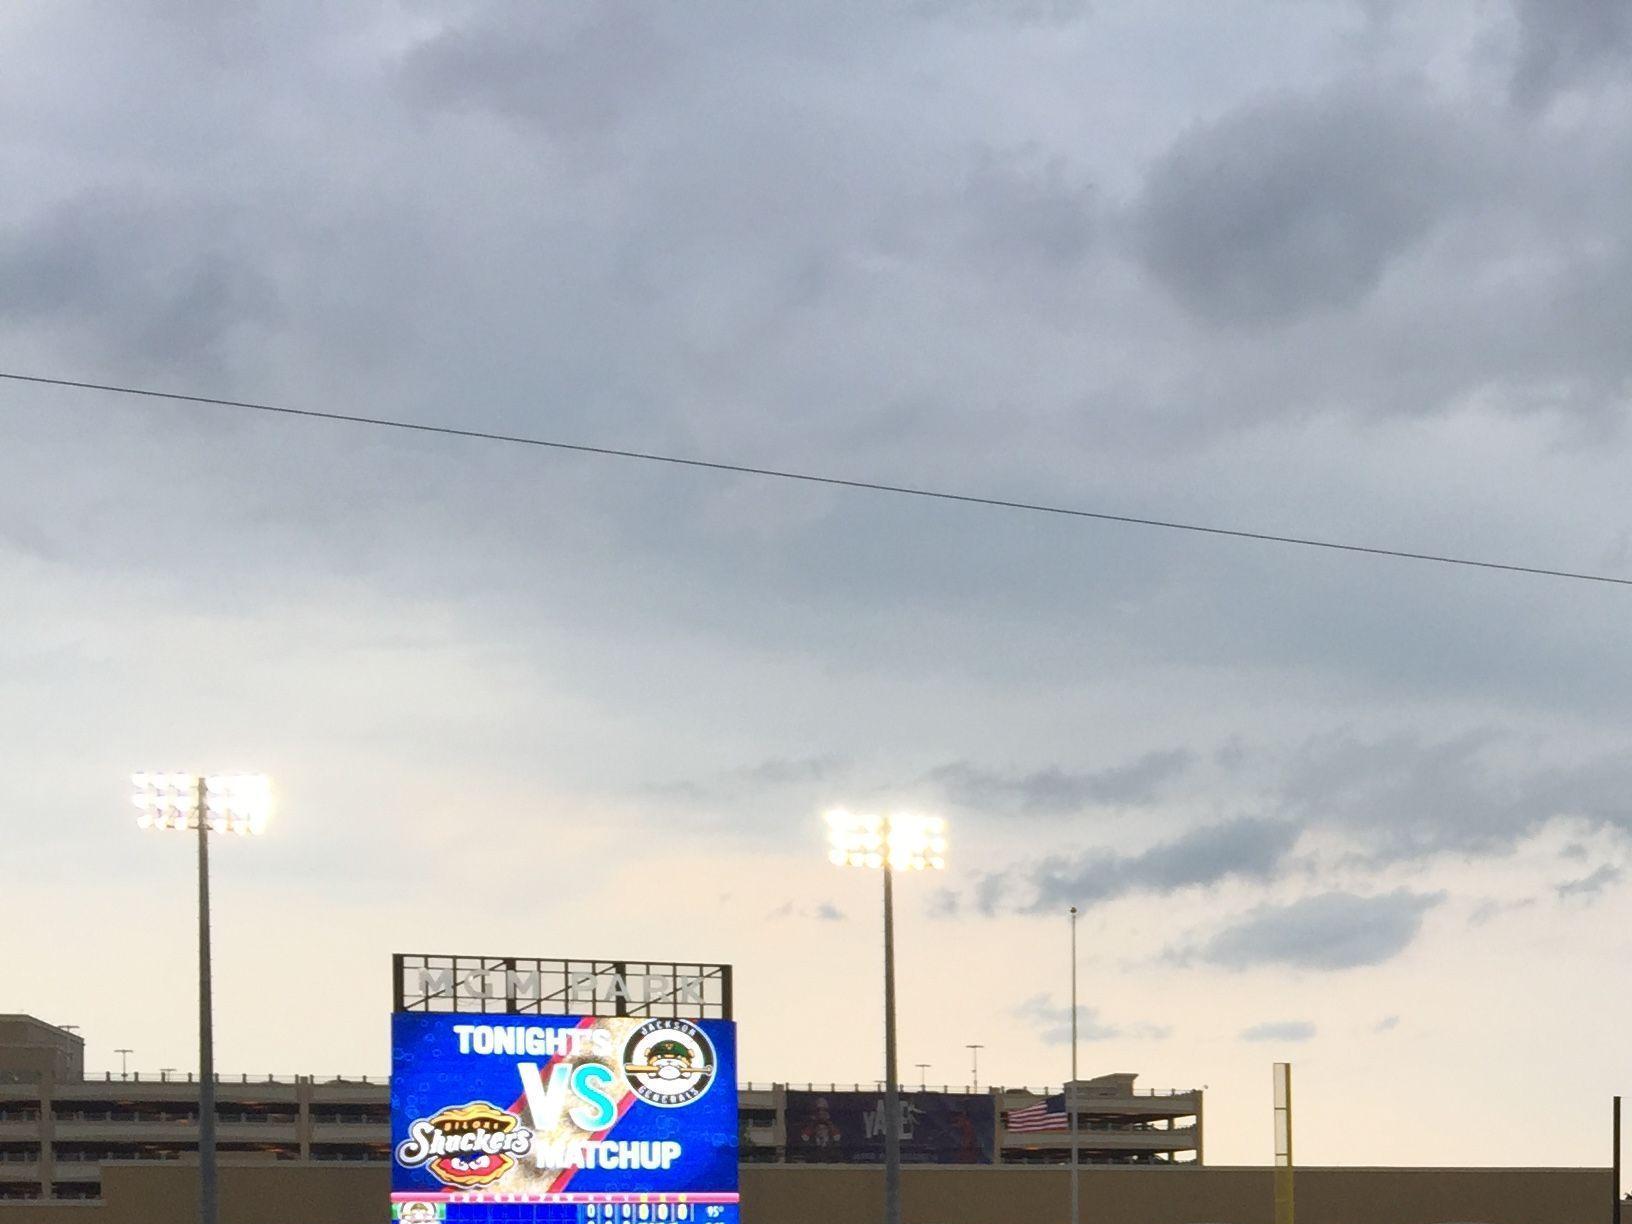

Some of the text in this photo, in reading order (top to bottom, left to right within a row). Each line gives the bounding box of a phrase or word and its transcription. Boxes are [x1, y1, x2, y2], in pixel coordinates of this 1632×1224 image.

[418, 966, 705, 1006] MGM PARK
[517, 1062, 618, 1132] VS
[400, 1120, 533, 1163] Shuckers
[536, 1140, 681, 1170] MATCHUP
